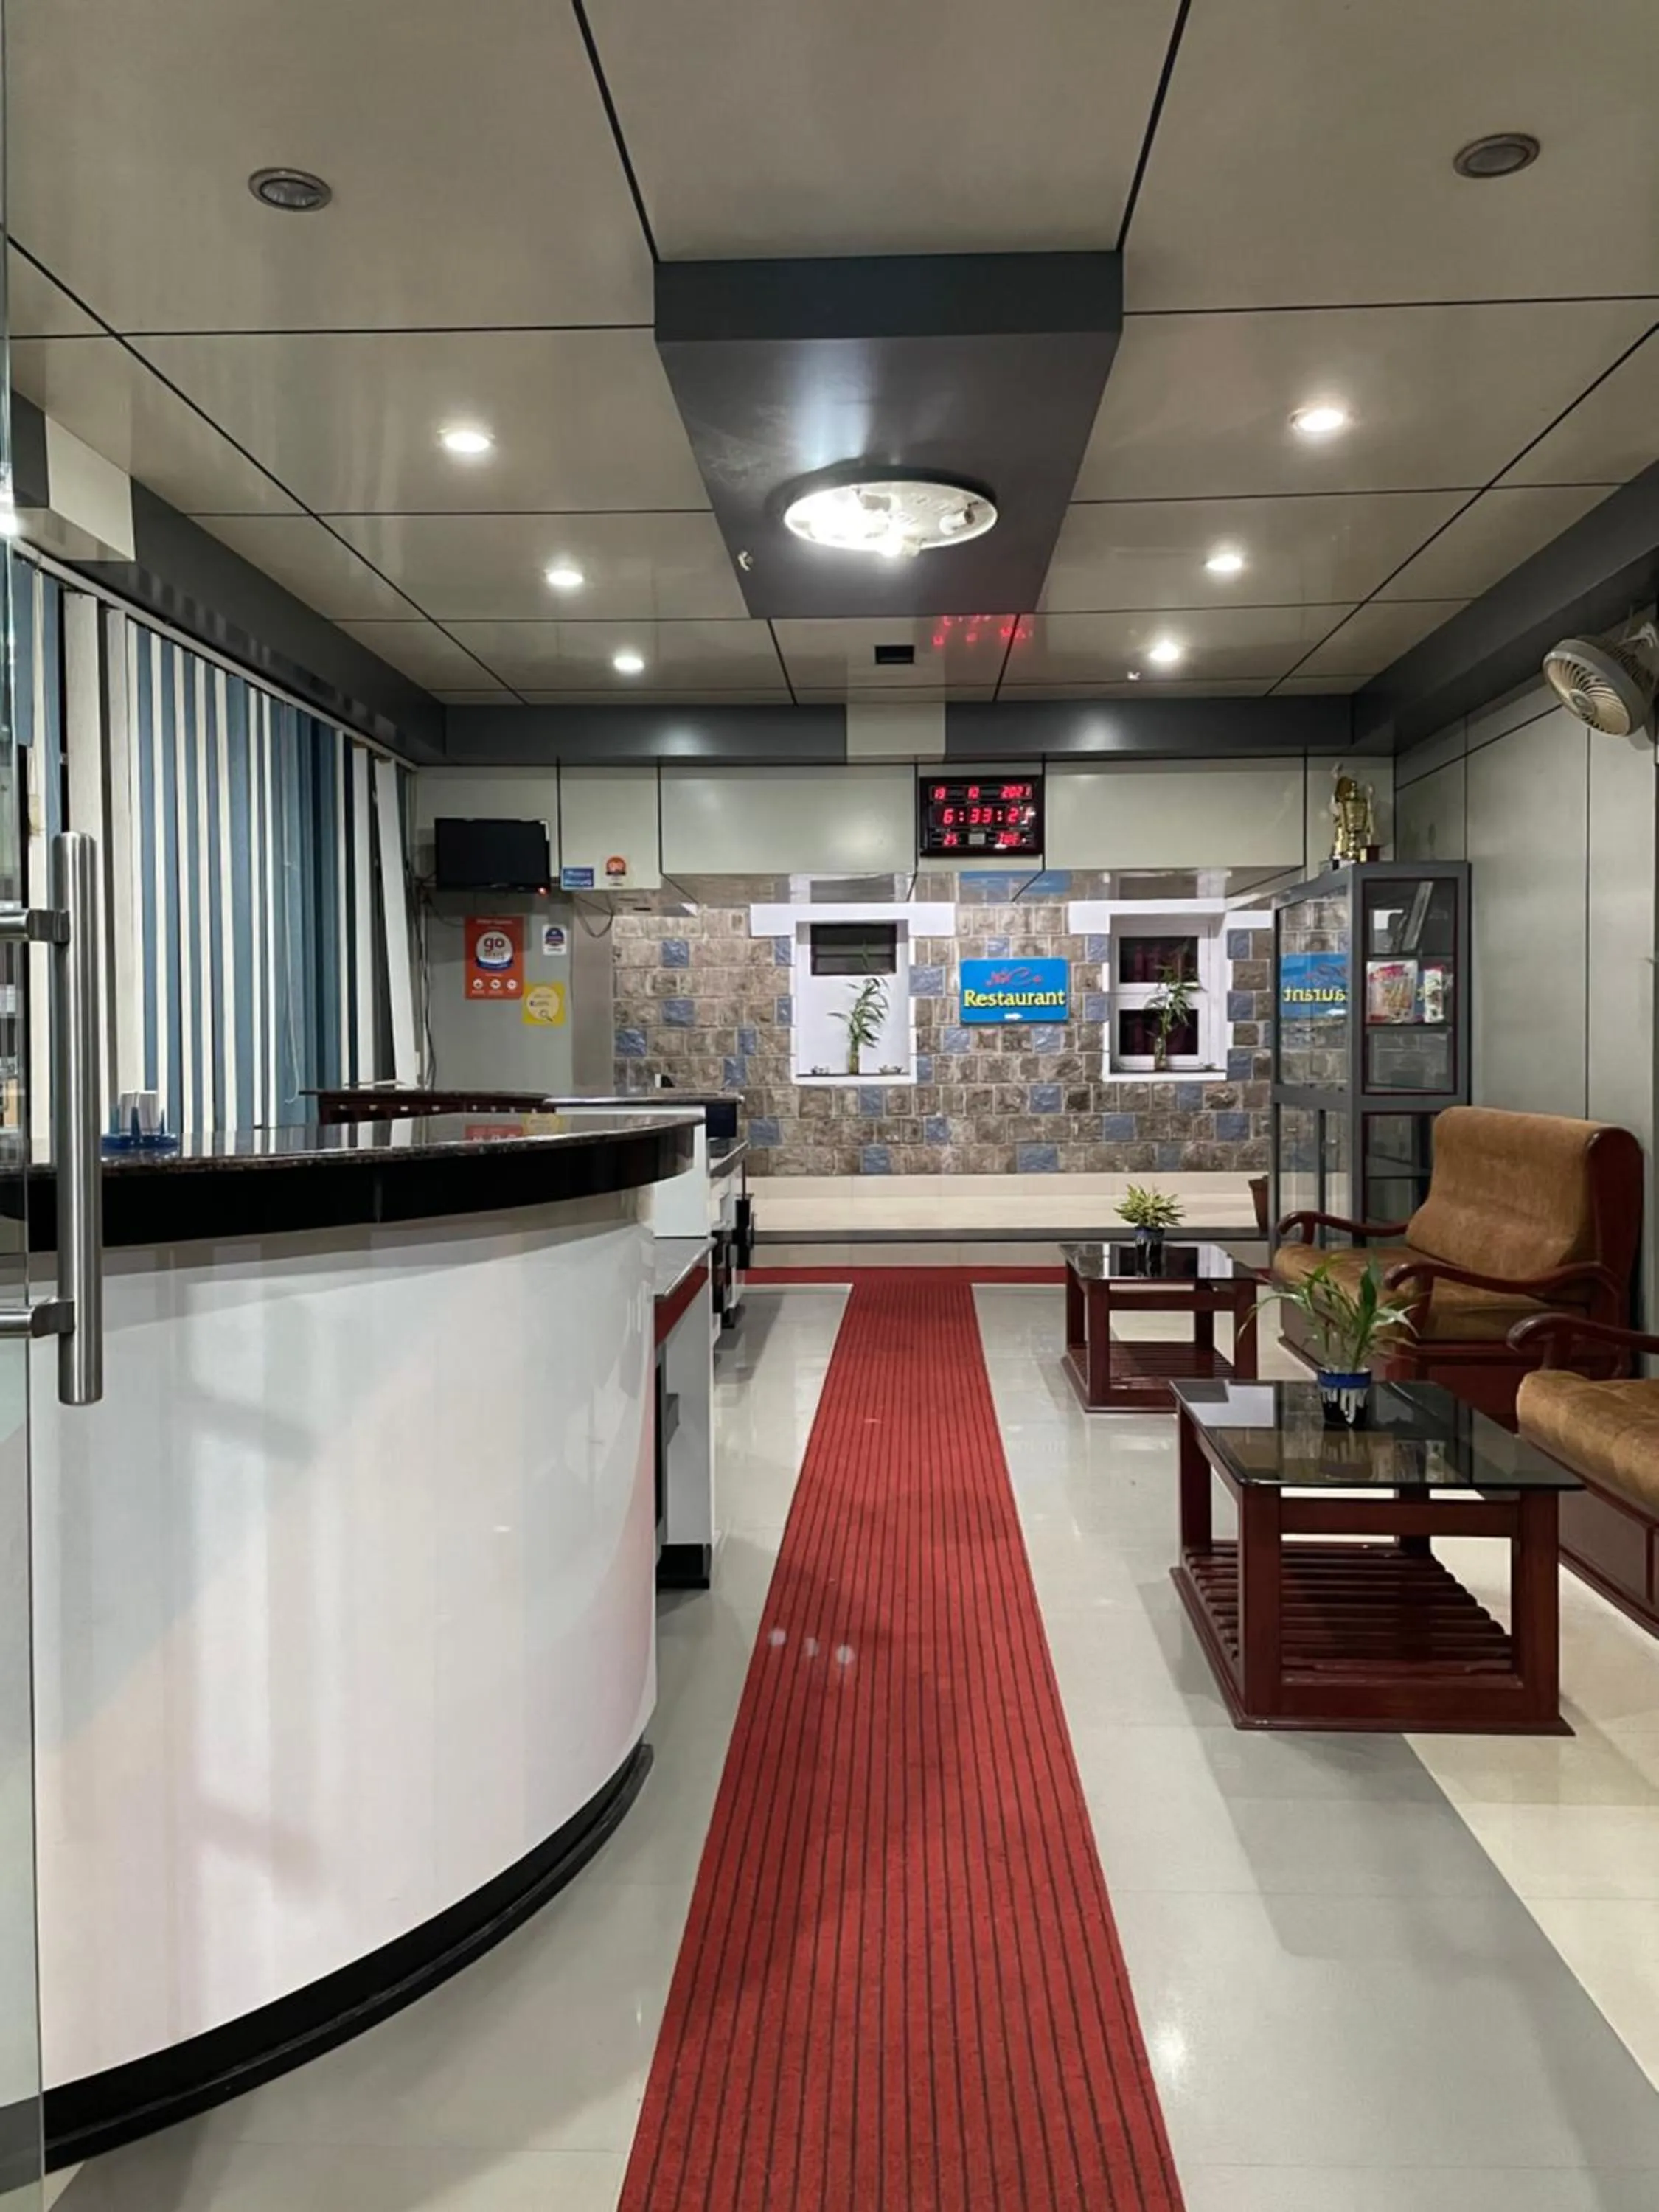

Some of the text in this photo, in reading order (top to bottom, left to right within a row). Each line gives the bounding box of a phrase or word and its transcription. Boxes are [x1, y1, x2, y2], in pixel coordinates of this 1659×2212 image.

[1001, 785, 1031, 799] 2021
[484, 937, 505, 953] go
[963, 989, 1065, 1006] Restaurant
